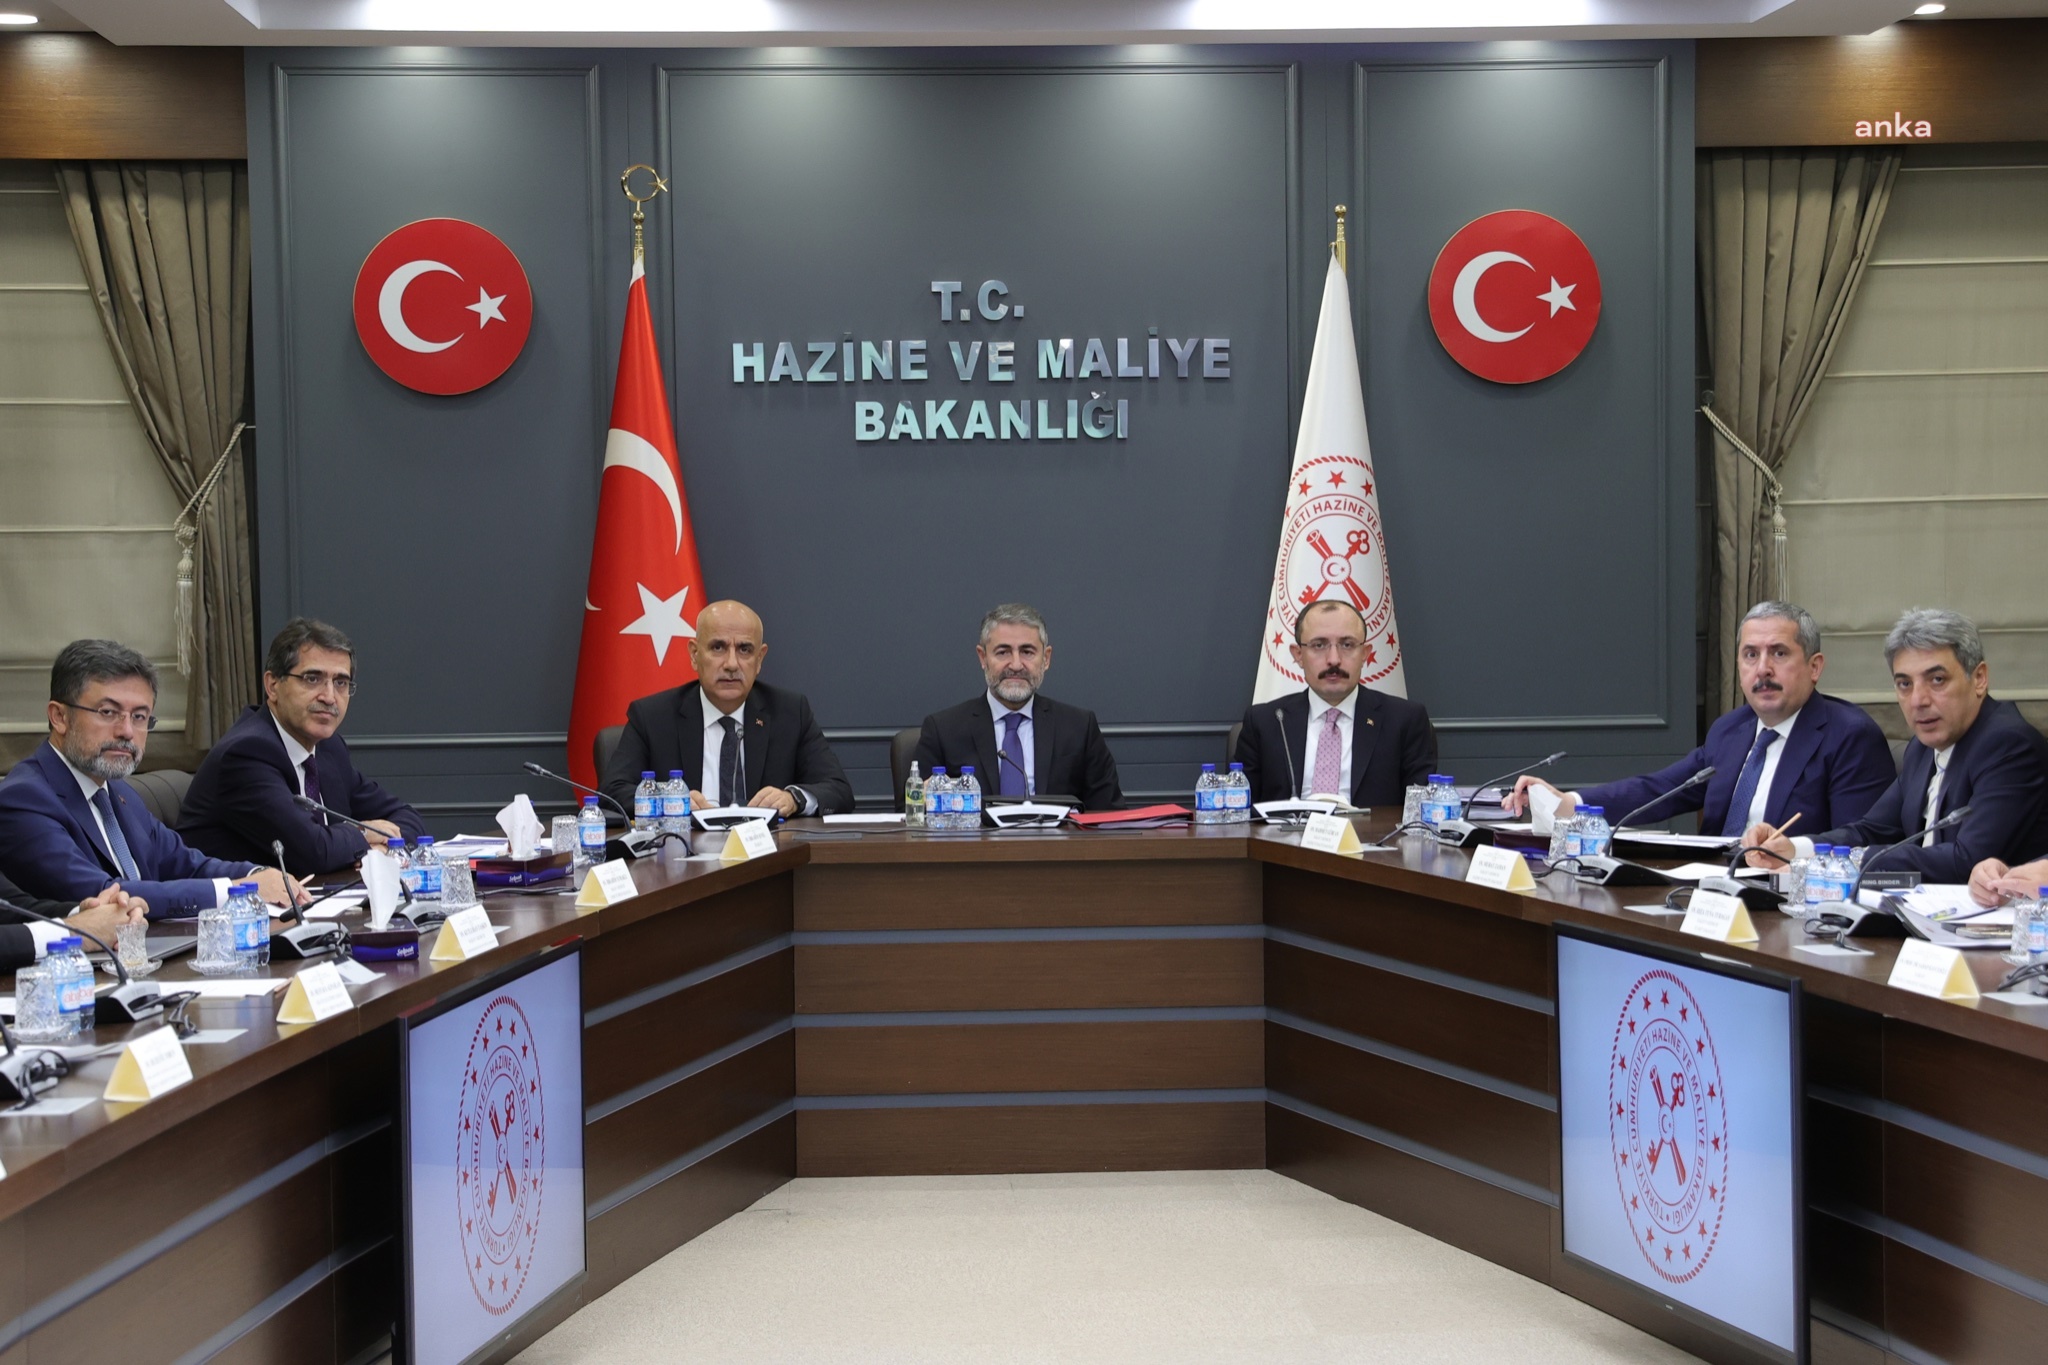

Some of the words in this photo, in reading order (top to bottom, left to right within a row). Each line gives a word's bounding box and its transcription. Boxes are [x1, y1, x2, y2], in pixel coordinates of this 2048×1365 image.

[931, 279, 1025, 321] T.C.
[732, 331, 928, 383] HAZİNE
[948, 341, 1016, 382] VE
[1038, 326, 1231, 379] MALİYE
[855, 390, 1129, 441] BAKANLIĞI
[1312, 498, 1366, 518] HAZİNE
[1366, 512, 1379, 530] VE
[489, 1051, 512, 1078] HAZİNE
[1629, 1031, 1651, 1153] CUMHURİYETİ
[1651, 1026, 1681, 1053] HAZİNE
[1682, 1047, 1692, 1072] VE
[1691, 1074, 1705, 1149] MALİYE
